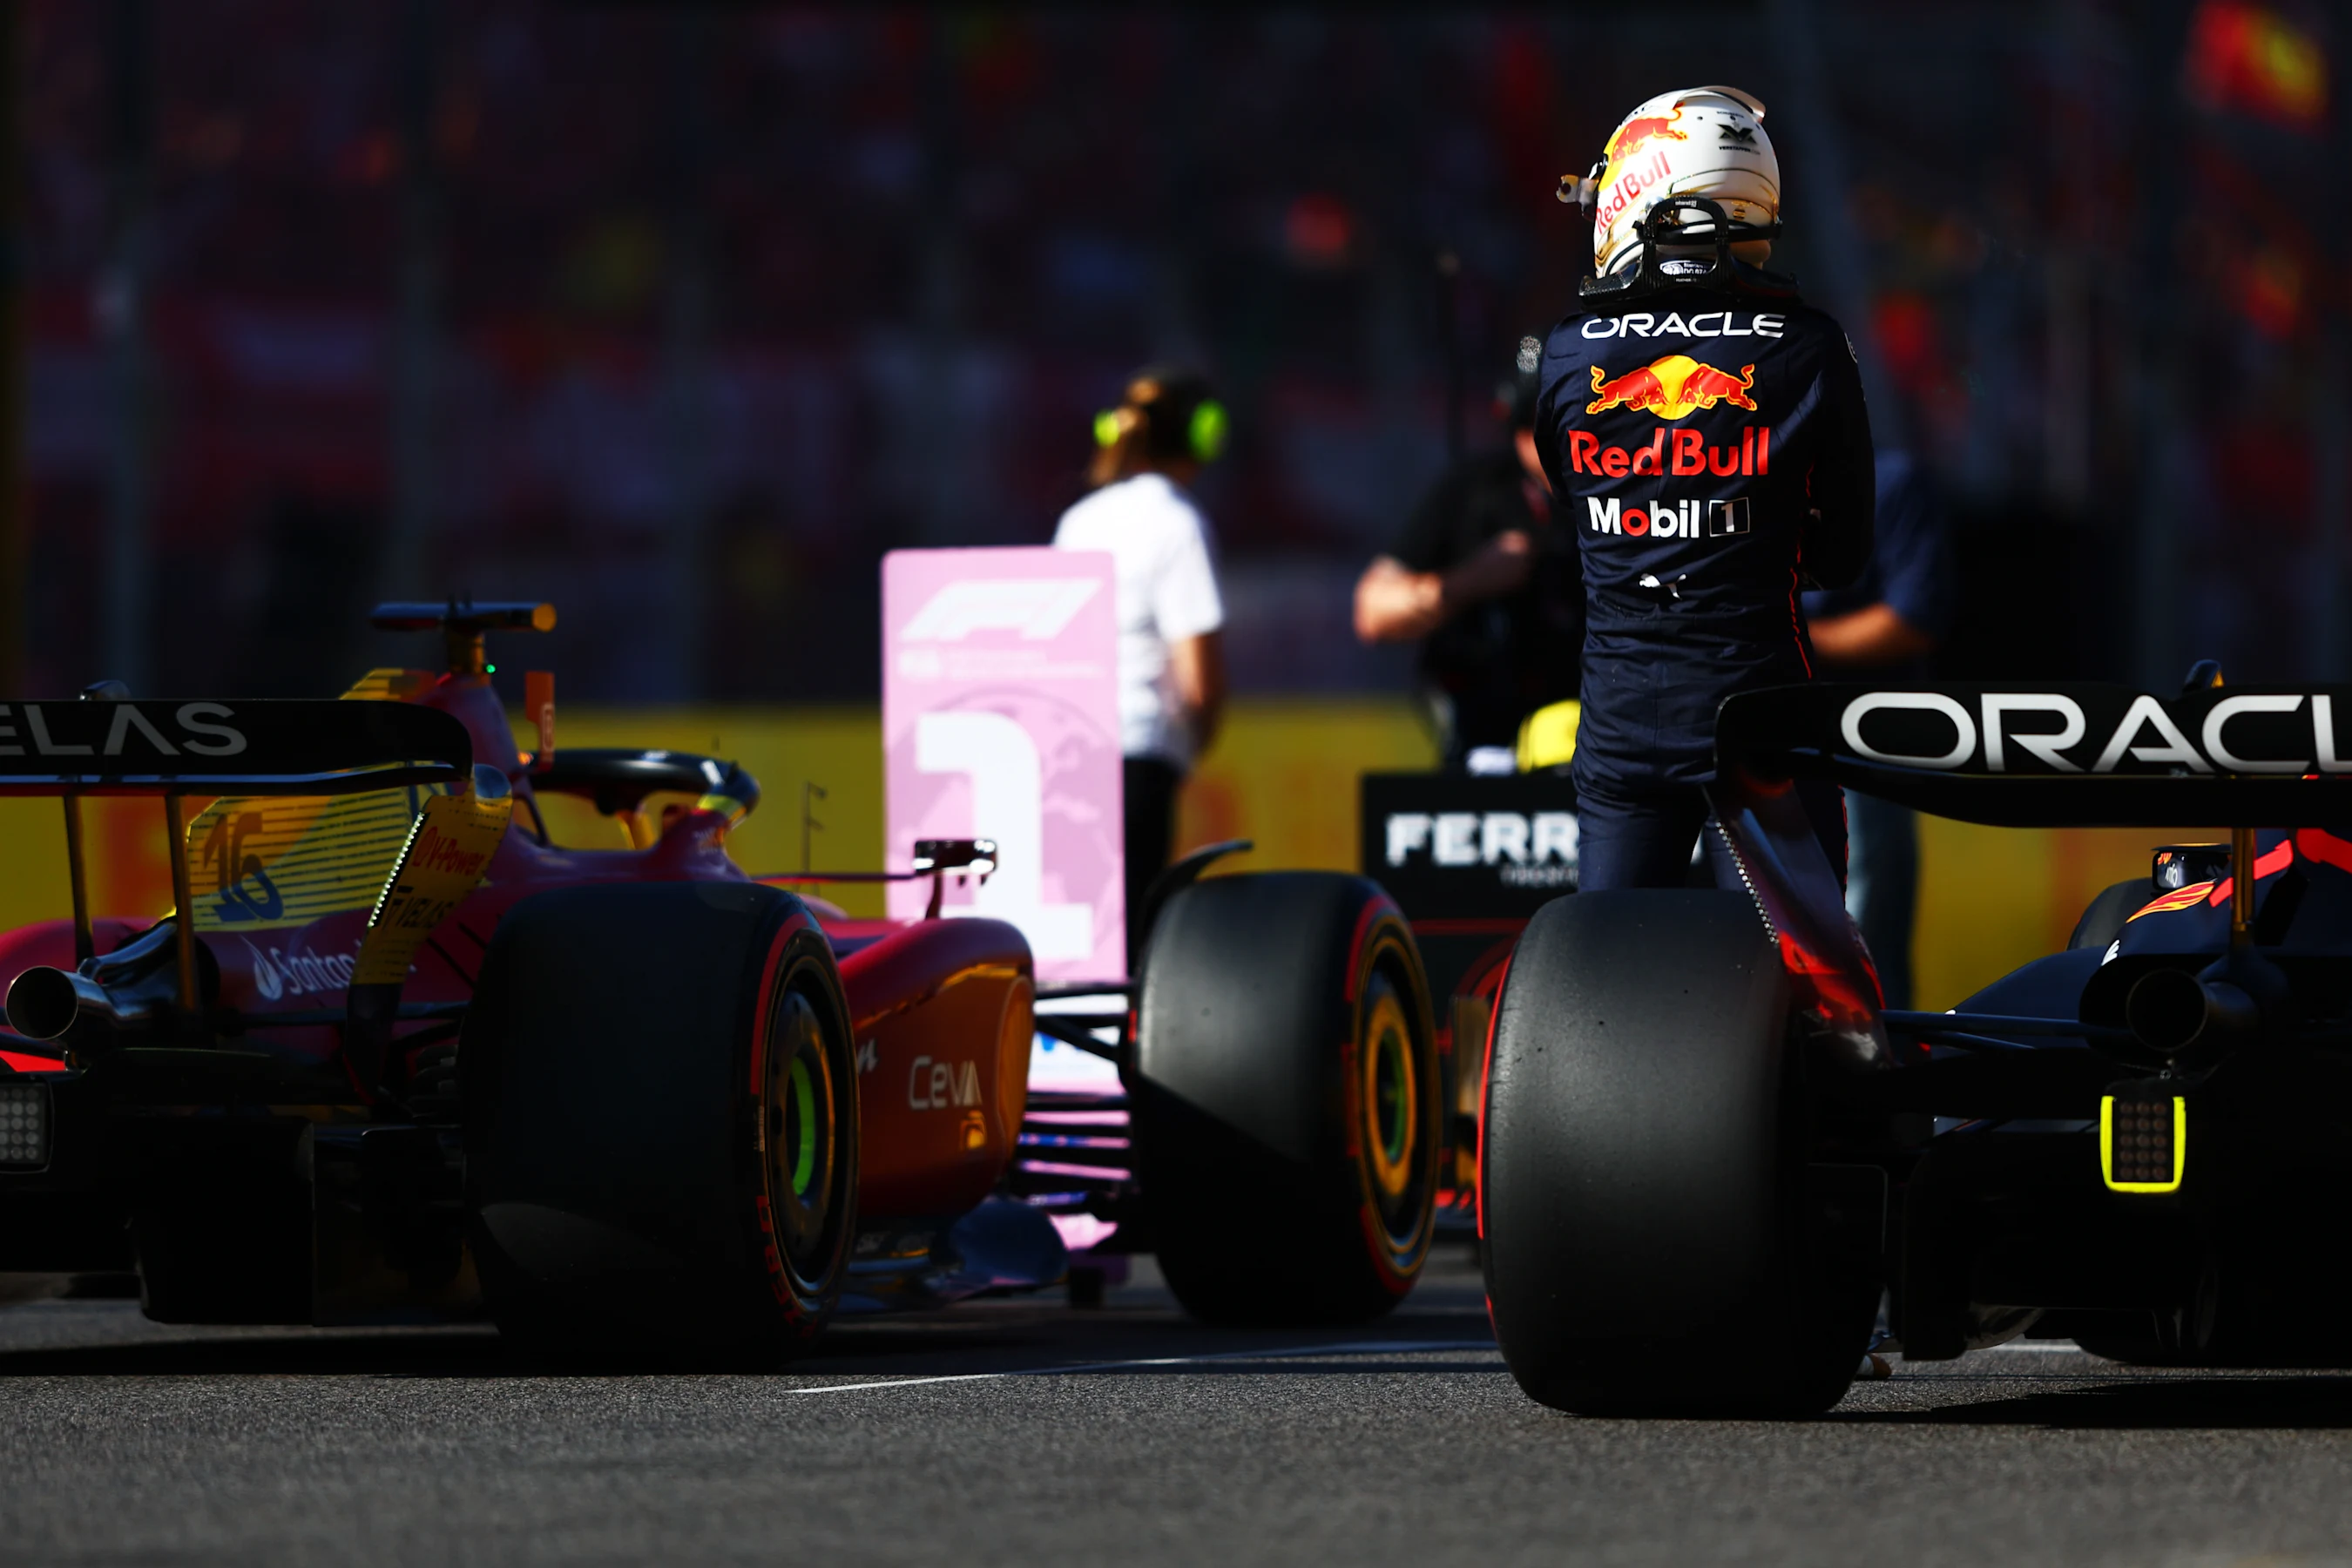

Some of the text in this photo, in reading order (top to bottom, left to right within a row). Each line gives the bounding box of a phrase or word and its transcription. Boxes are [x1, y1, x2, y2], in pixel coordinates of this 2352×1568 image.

[1596, 151, 1672, 234] Red Bull
[1581, 312, 1786, 339] ORACLE
[1568, 426, 1769, 477] Red Bull
[1587, 496, 1700, 538] Mobil
[426, 835, 485, 875] V-Power
[917, 712, 1092, 961] 1
[204, 811, 284, 922] 16
